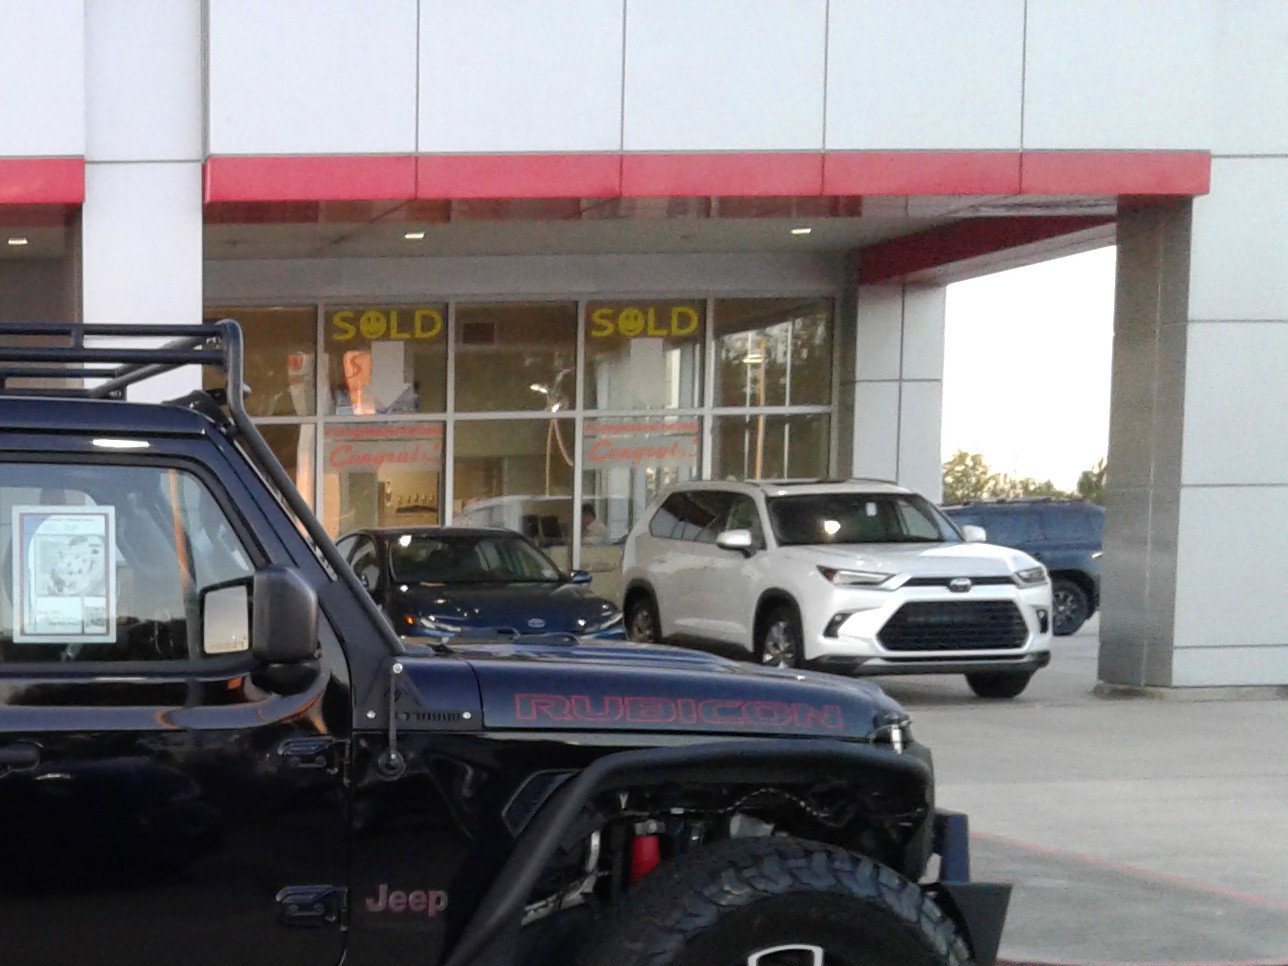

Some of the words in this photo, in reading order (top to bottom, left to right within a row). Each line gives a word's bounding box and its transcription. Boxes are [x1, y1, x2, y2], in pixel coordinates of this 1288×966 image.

[331, 308, 443, 340] SOLD
[591, 305, 699, 337] SOLD
[514, 693, 845, 730] RUBICON
[365, 883, 449, 917] Jeep
